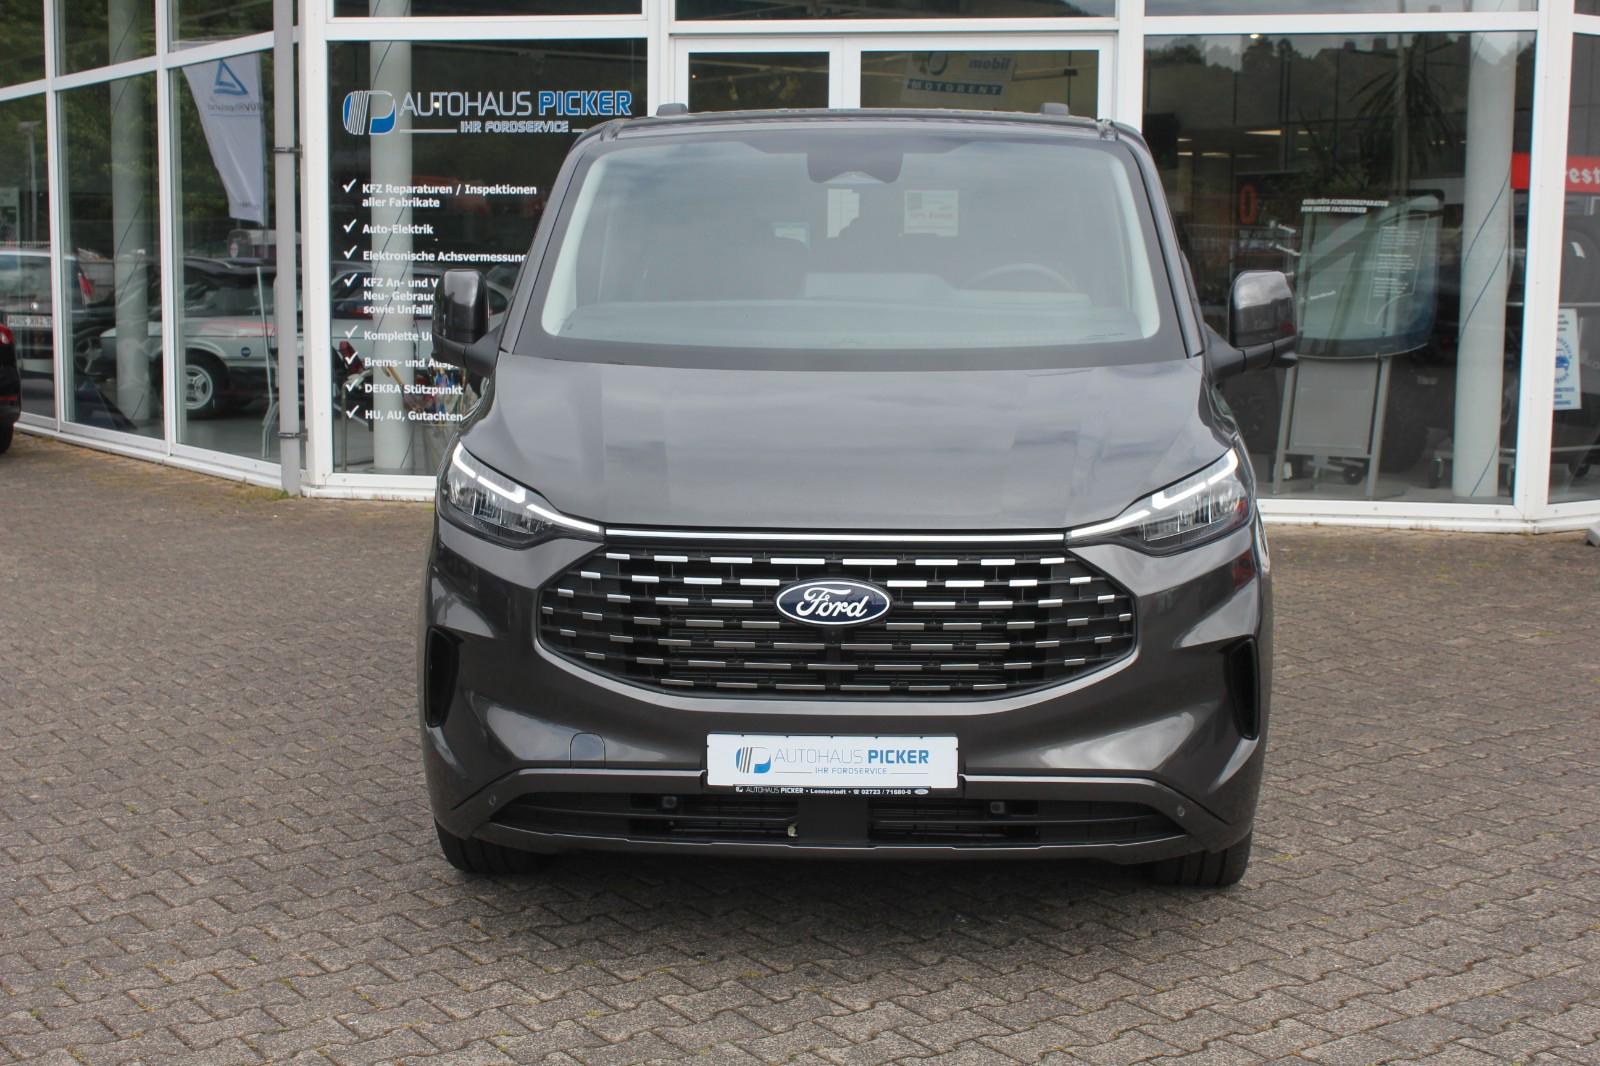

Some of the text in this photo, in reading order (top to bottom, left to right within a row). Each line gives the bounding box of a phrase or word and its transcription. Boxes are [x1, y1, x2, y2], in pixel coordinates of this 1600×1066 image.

[400, 90, 632, 116] AUTOHAUS PICKER
[460, 120, 569, 133] IHR FORDSERVICE
[1565, 167, 1600, 185] est
[362, 184, 383, 195] KFZ
[385, 184, 453, 197] Reparaturen
[465, 184, 537, 197] Inspektionen
[362, 197, 440, 208] aller Fabrikate
[362, 224, 434, 235] Auto-Elektrik
[363, 251, 435, 262] Elektronische
[363, 278, 383, 287] KFZ
[386, 278, 404, 287] An-
[408, 277, 428, 288] und
[363, 291, 435, 302] Neu- Gebrauc
[363, 304, 434, 315] sowie Unfallf
[364, 331, 418, 343] Komplette
[364, 357, 402, 367] Brems-
[405, 357, 425, 368] und
[364, 384, 464, 396] DEKRA Stützpunkt
[365, 411, 464, 422] HU, AU, Gutachten
[796, 587, 869, 617] Ford
[774, 748, 929, 765] AUTOHAUS PICKER
[815, 767, 887, 776] IHR FORDSERVICE
[745, 786, 780, 794] AUTOHAUS
[780, 787, 804, 795] PICKER
[810, 788, 847, 796] Lennestadt
